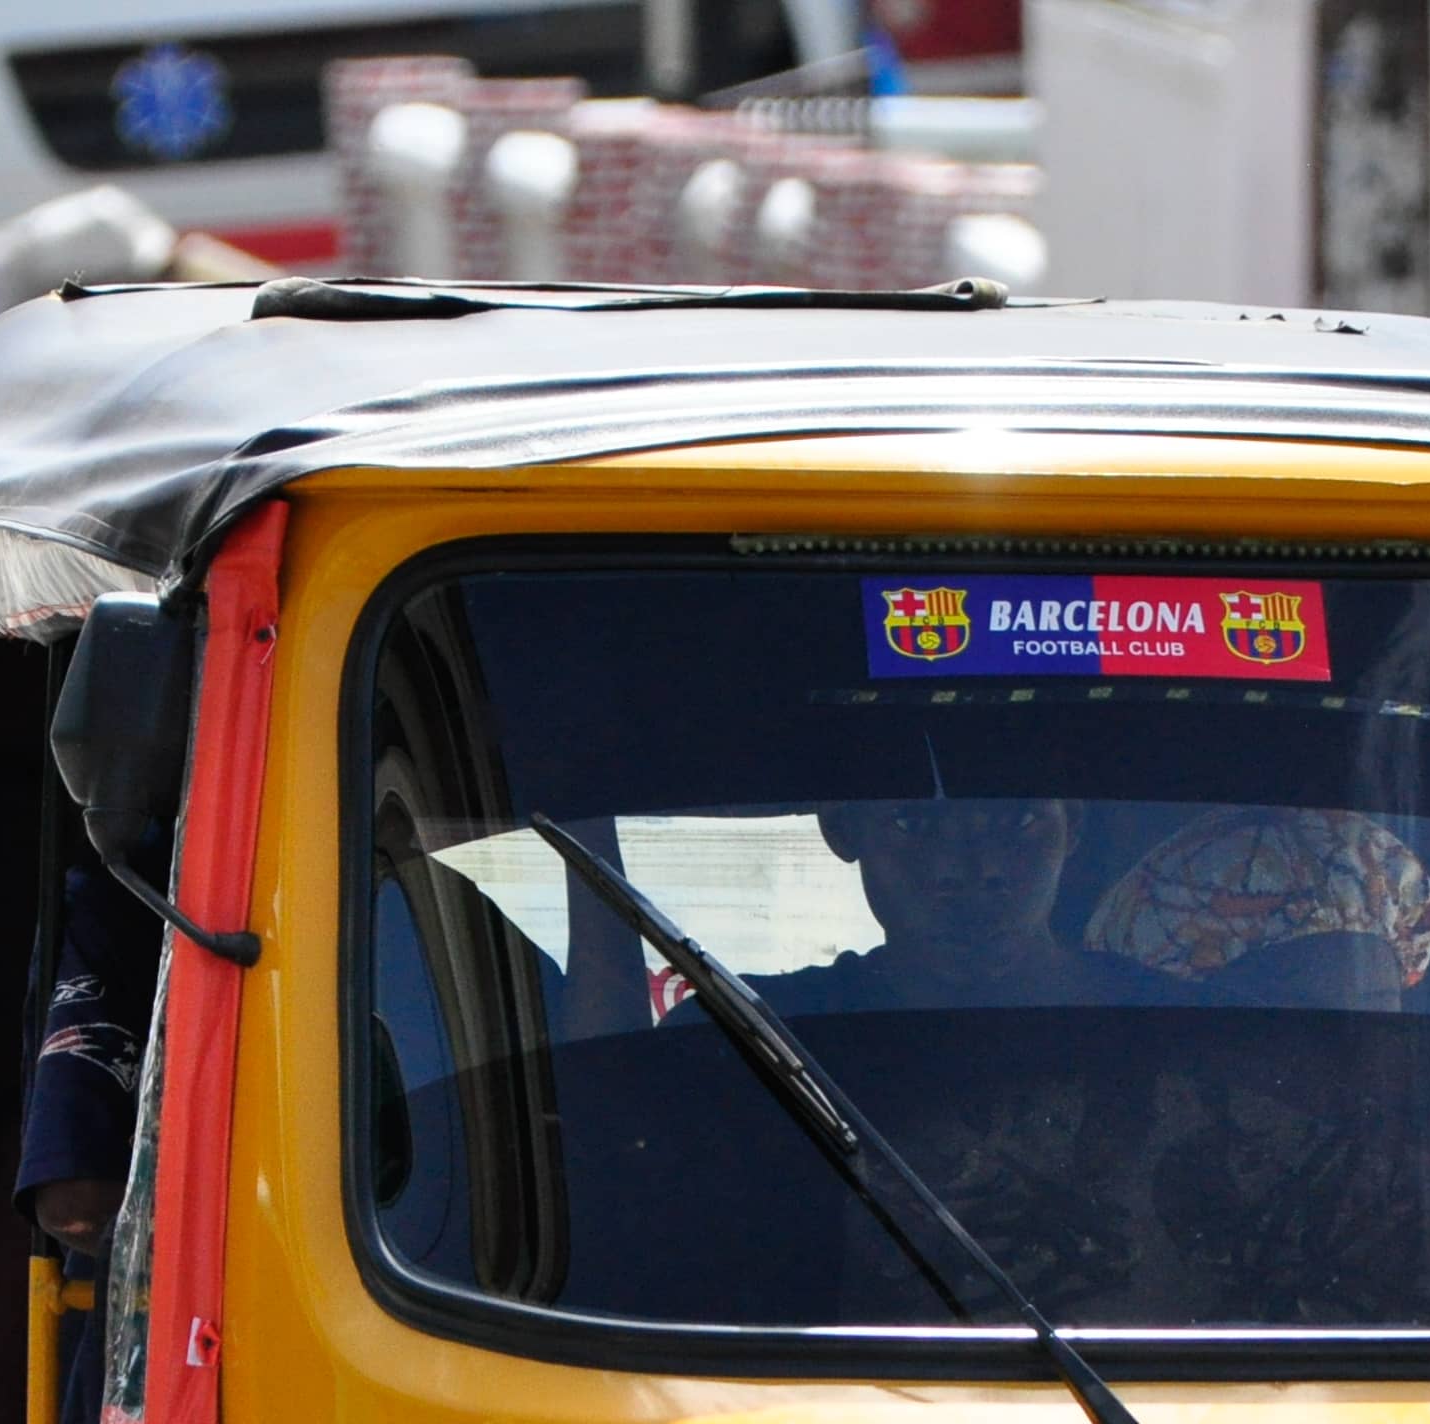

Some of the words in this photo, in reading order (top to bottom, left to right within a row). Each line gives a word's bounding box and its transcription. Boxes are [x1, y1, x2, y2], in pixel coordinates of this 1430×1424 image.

[989, 599, 1206, 634] BARCELONA
[1012, 640, 1124, 656] FOOTBALL
[1128, 640, 1186, 657] CLUB
